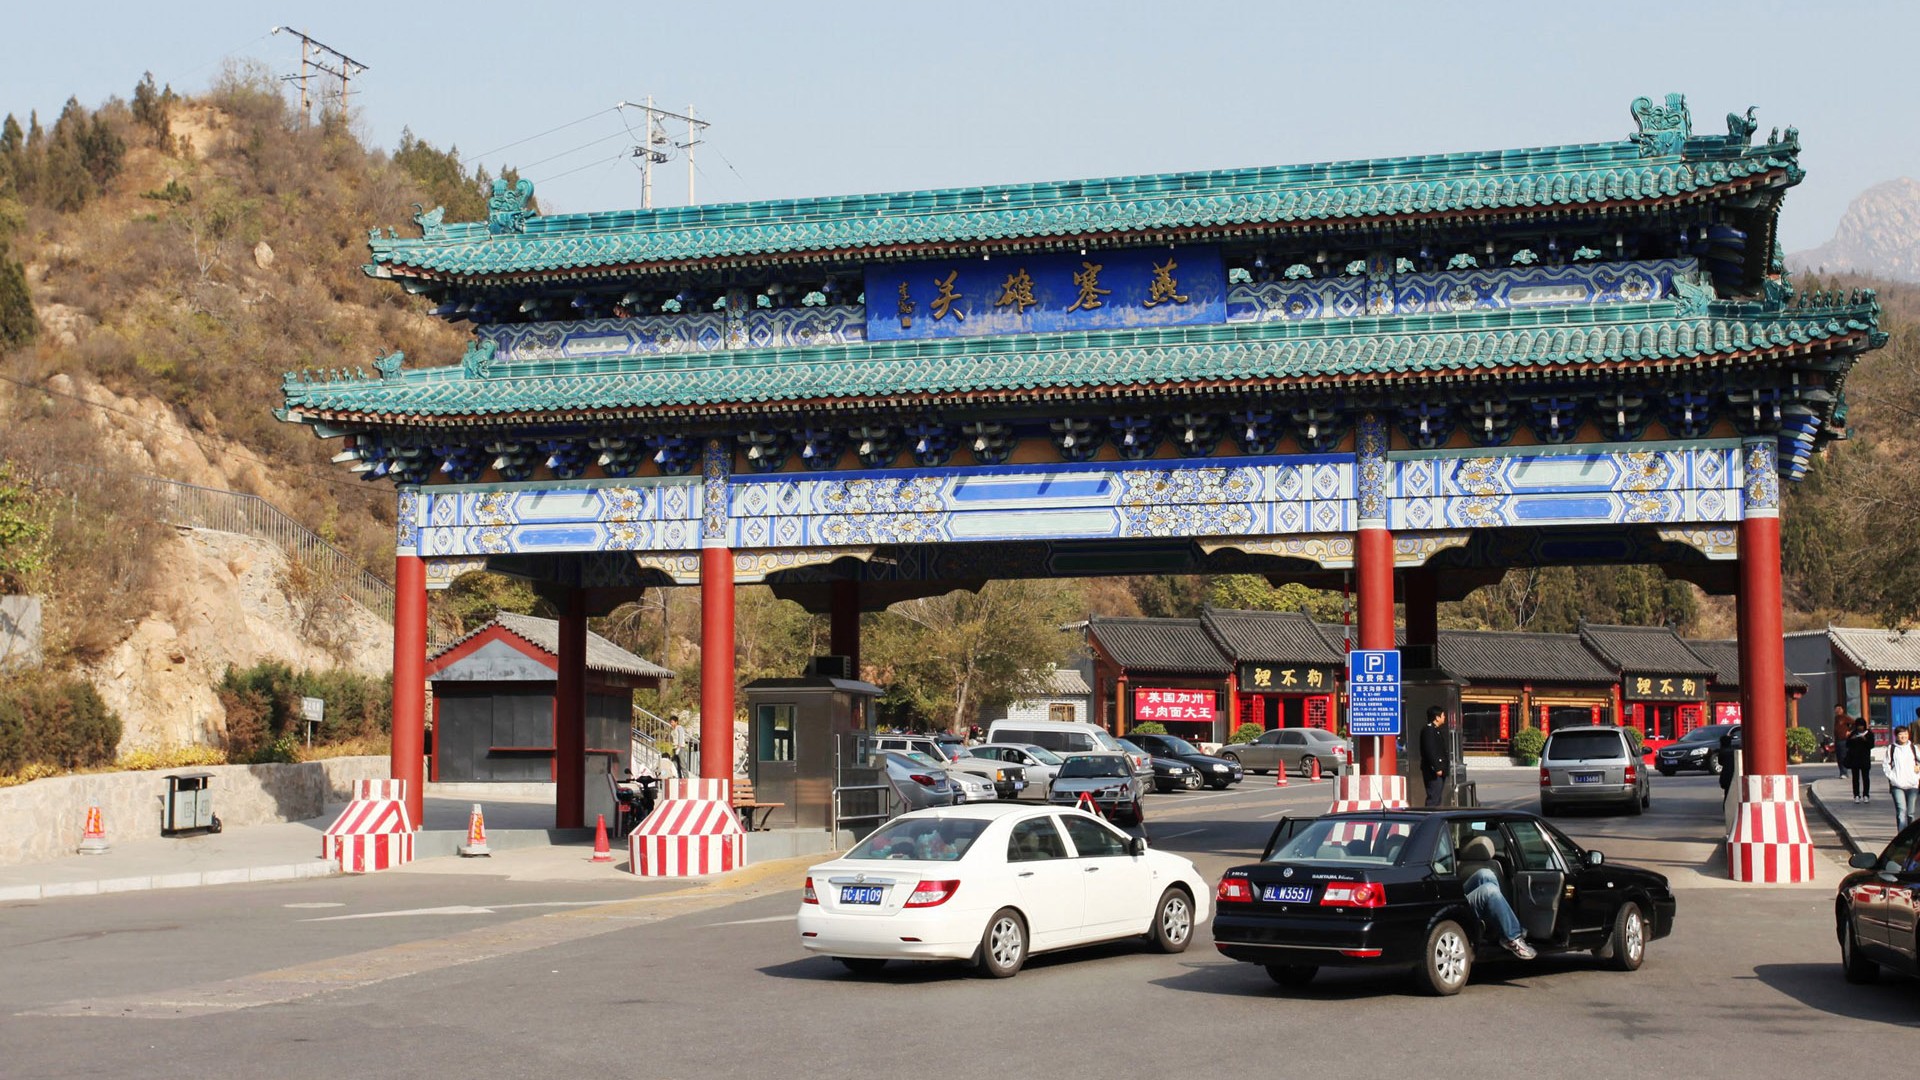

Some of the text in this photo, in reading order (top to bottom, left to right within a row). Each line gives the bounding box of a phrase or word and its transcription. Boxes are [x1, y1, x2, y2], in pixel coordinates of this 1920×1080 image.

[1368, 655, 1382, 671] P
[1147, 691, 1205, 705] 英国加州
[1140, 705, 1213, 719] 牛肉面大王
